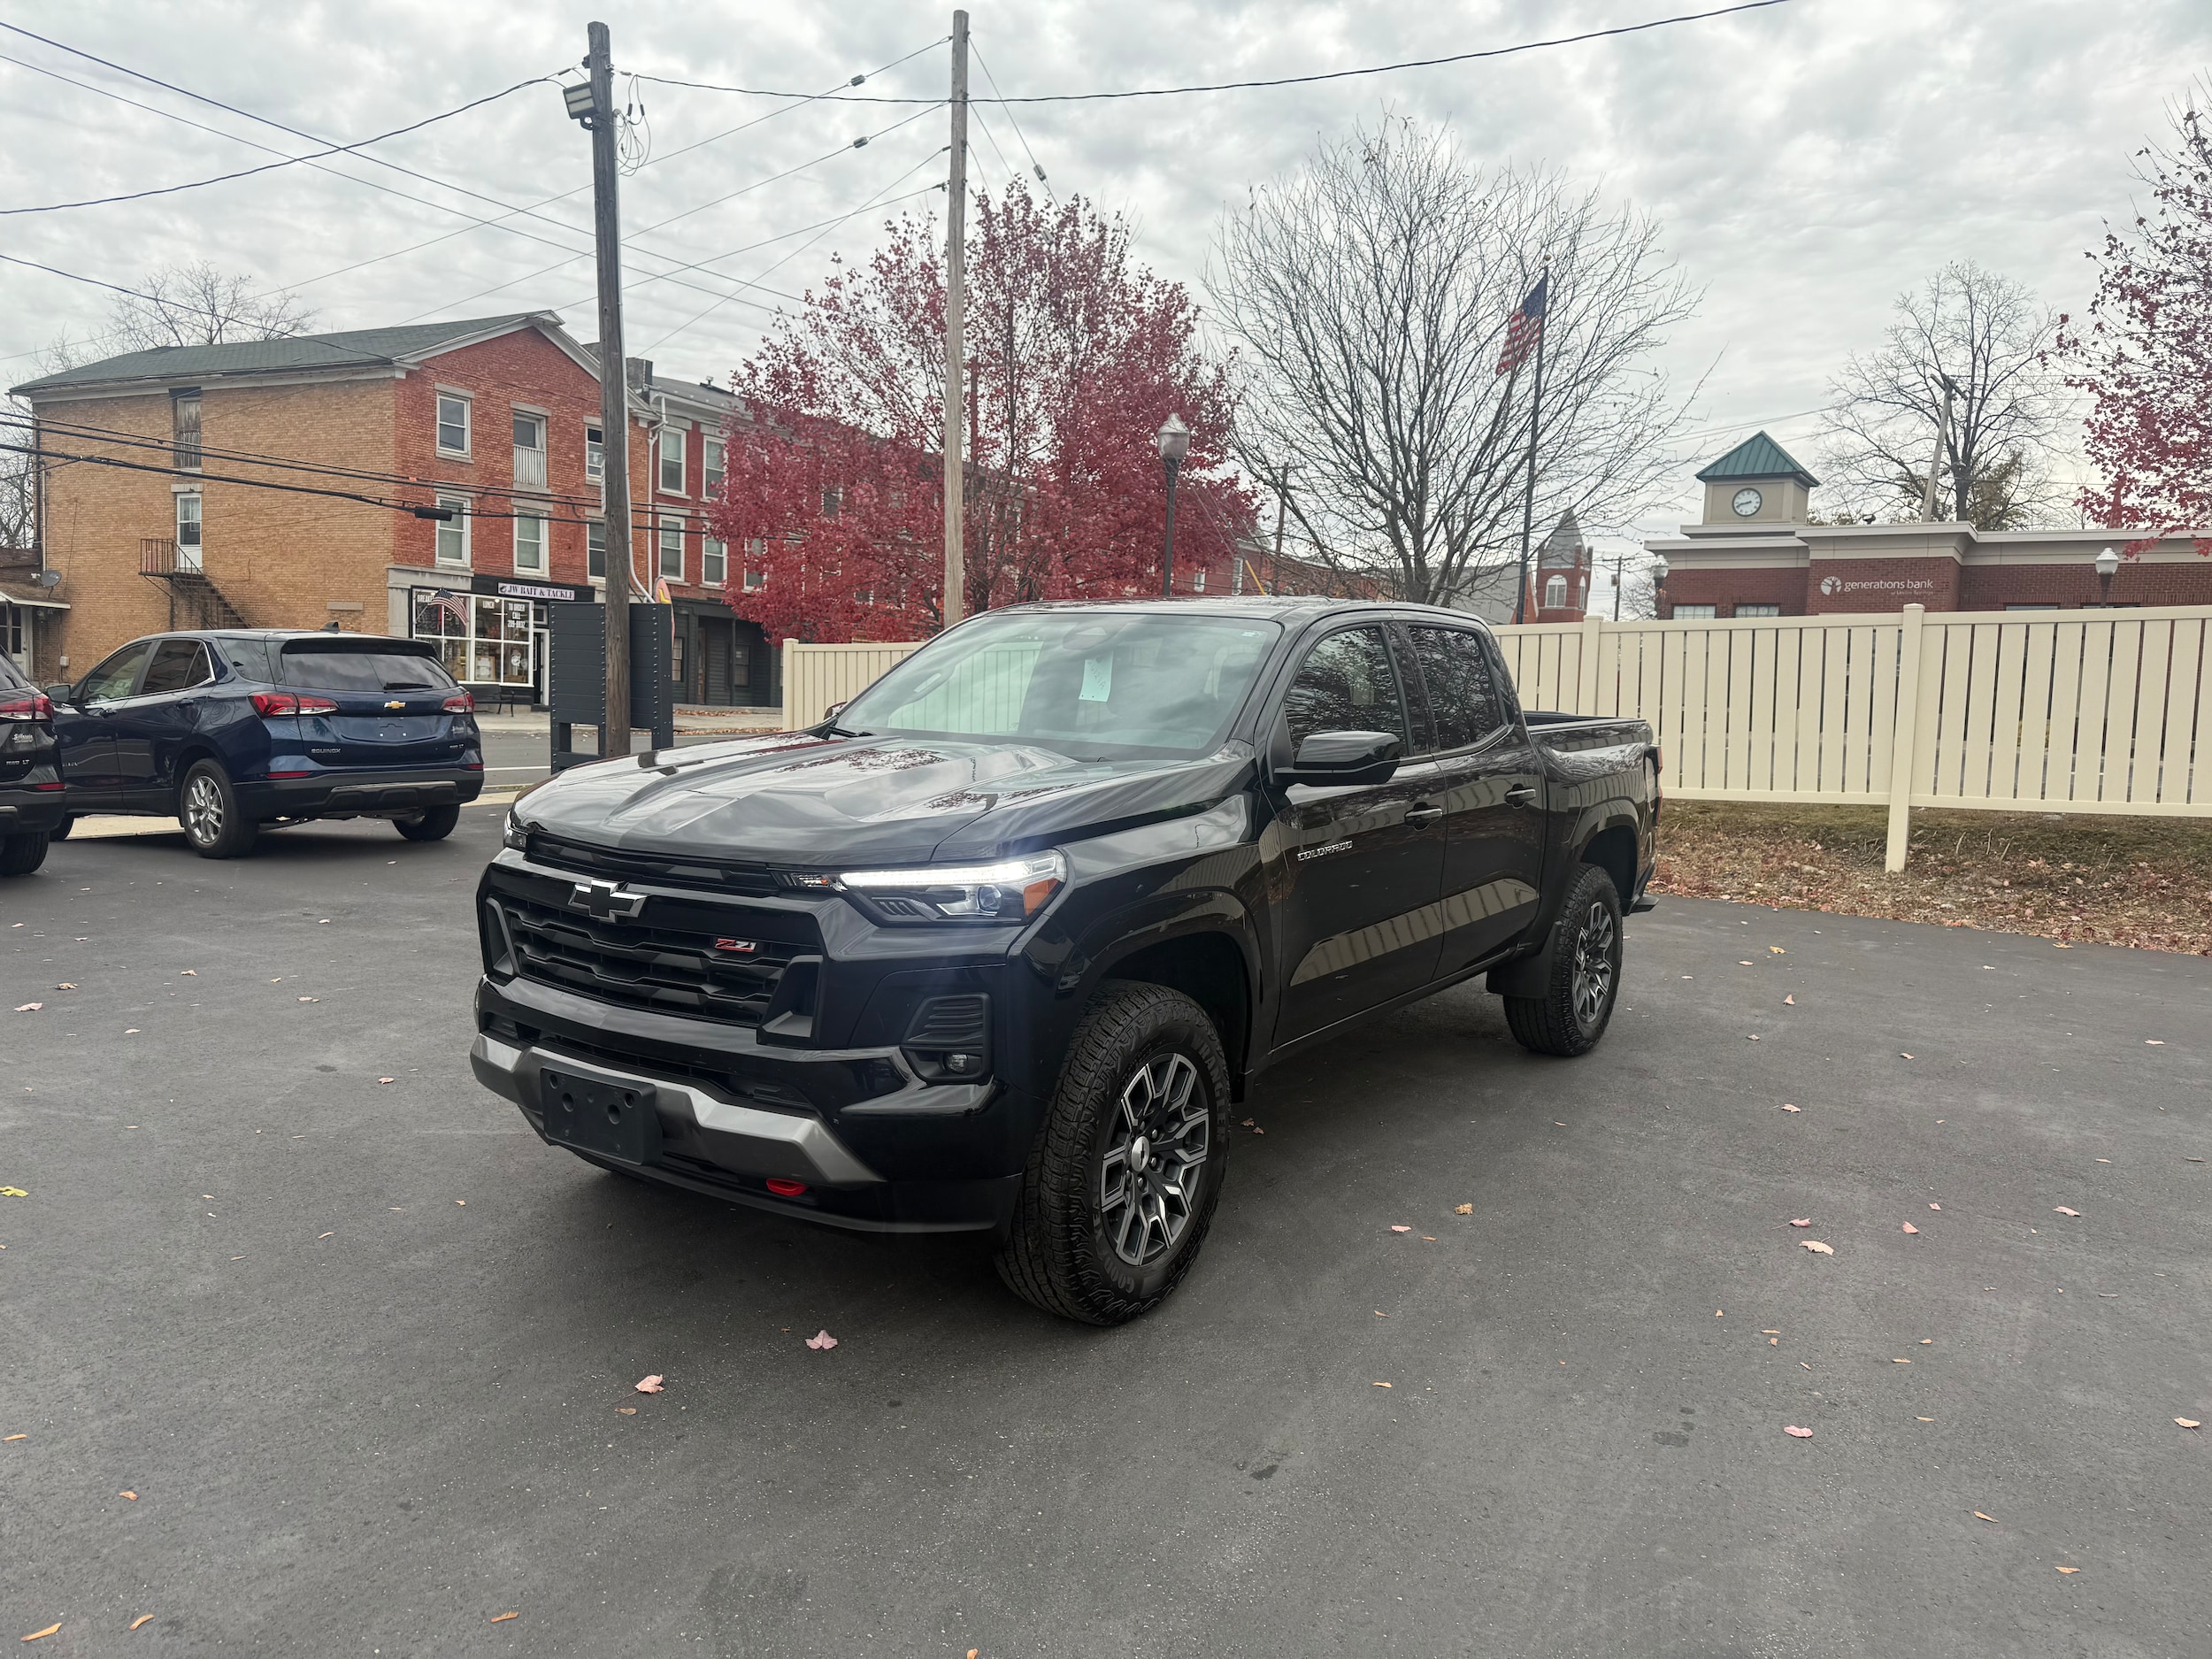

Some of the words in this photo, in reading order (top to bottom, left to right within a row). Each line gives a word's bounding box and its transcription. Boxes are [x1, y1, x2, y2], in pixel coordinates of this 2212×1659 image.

[520, 586, 538, 595] BAIT
[547, 588, 574, 599] TACKLE
[1843, 580, 1905, 592] generations
[1907, 579, 1934, 589] bank
[1296, 840, 1354, 862] COLORADO
[715, 938, 757, 953] Z71
